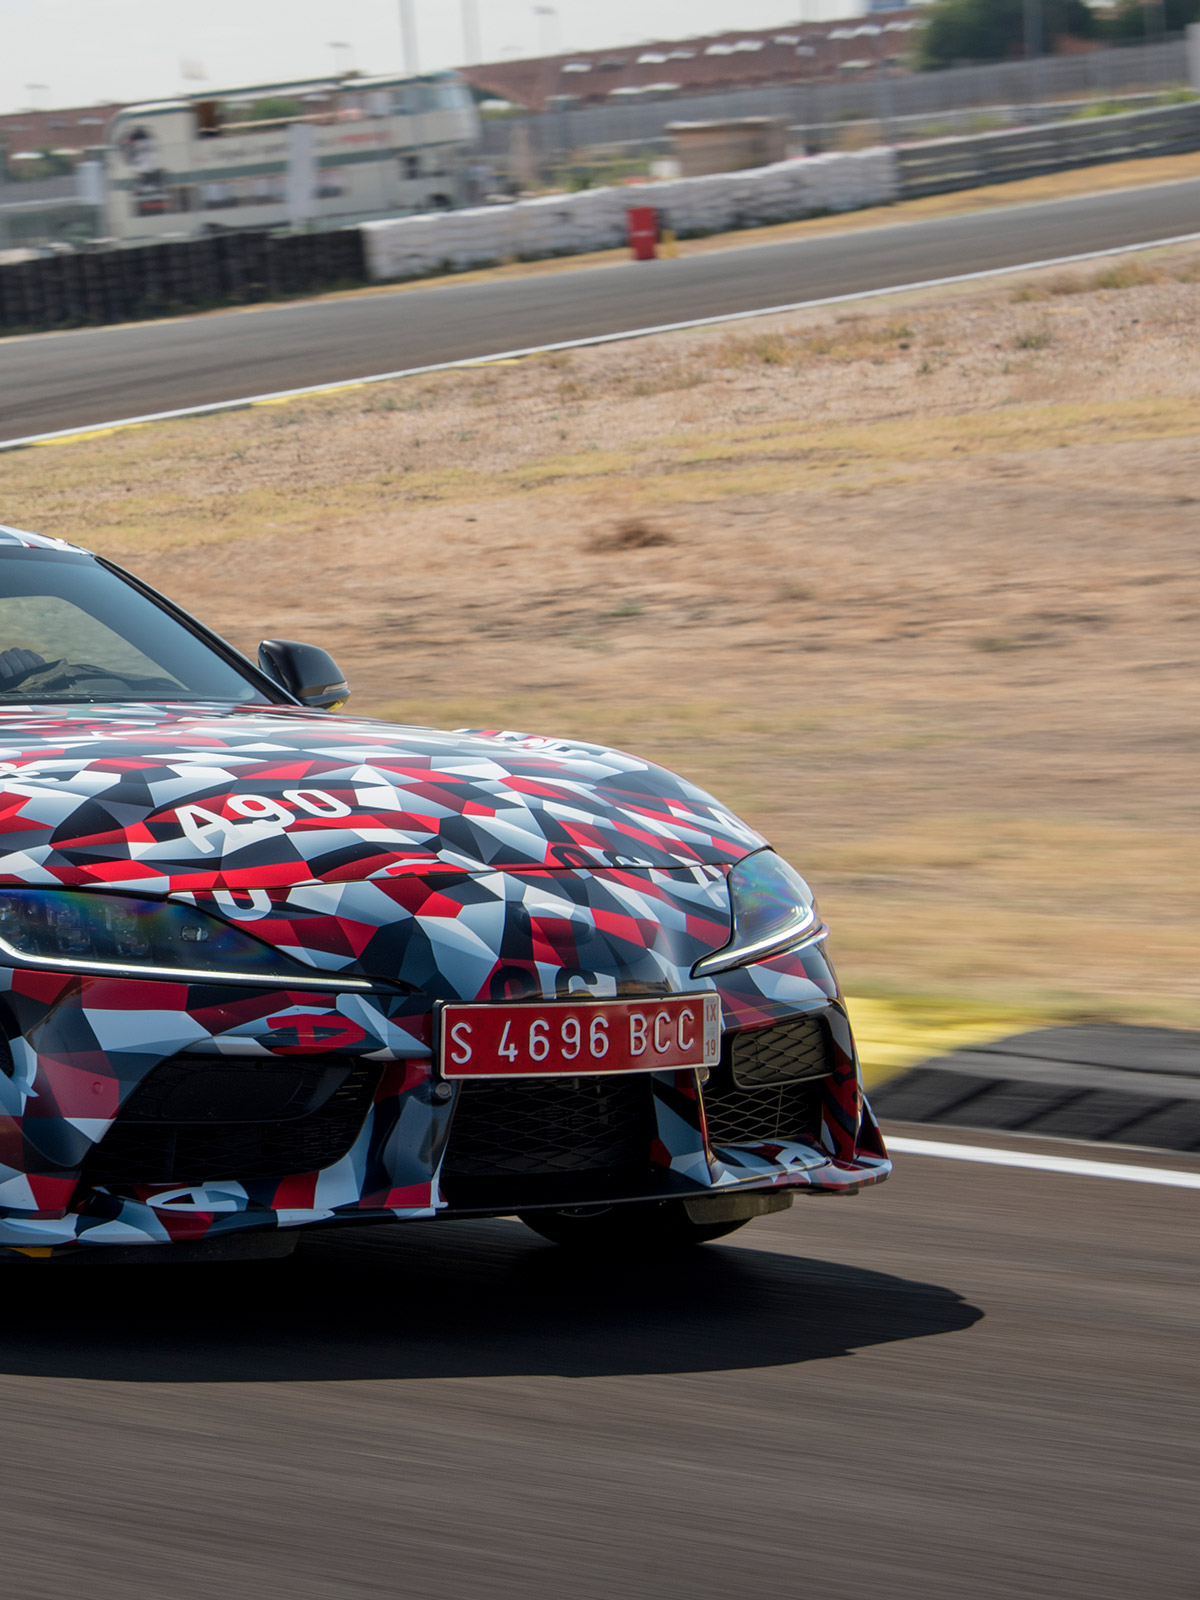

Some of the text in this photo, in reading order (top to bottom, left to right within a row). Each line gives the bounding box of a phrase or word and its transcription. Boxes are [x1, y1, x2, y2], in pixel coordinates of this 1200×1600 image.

[174, 788, 352, 854] A90
[705, 1003, 718, 1023] IX
[450, 1008, 695, 1064] S 4696 BCC
[705, 1038, 717, 1058] 19
